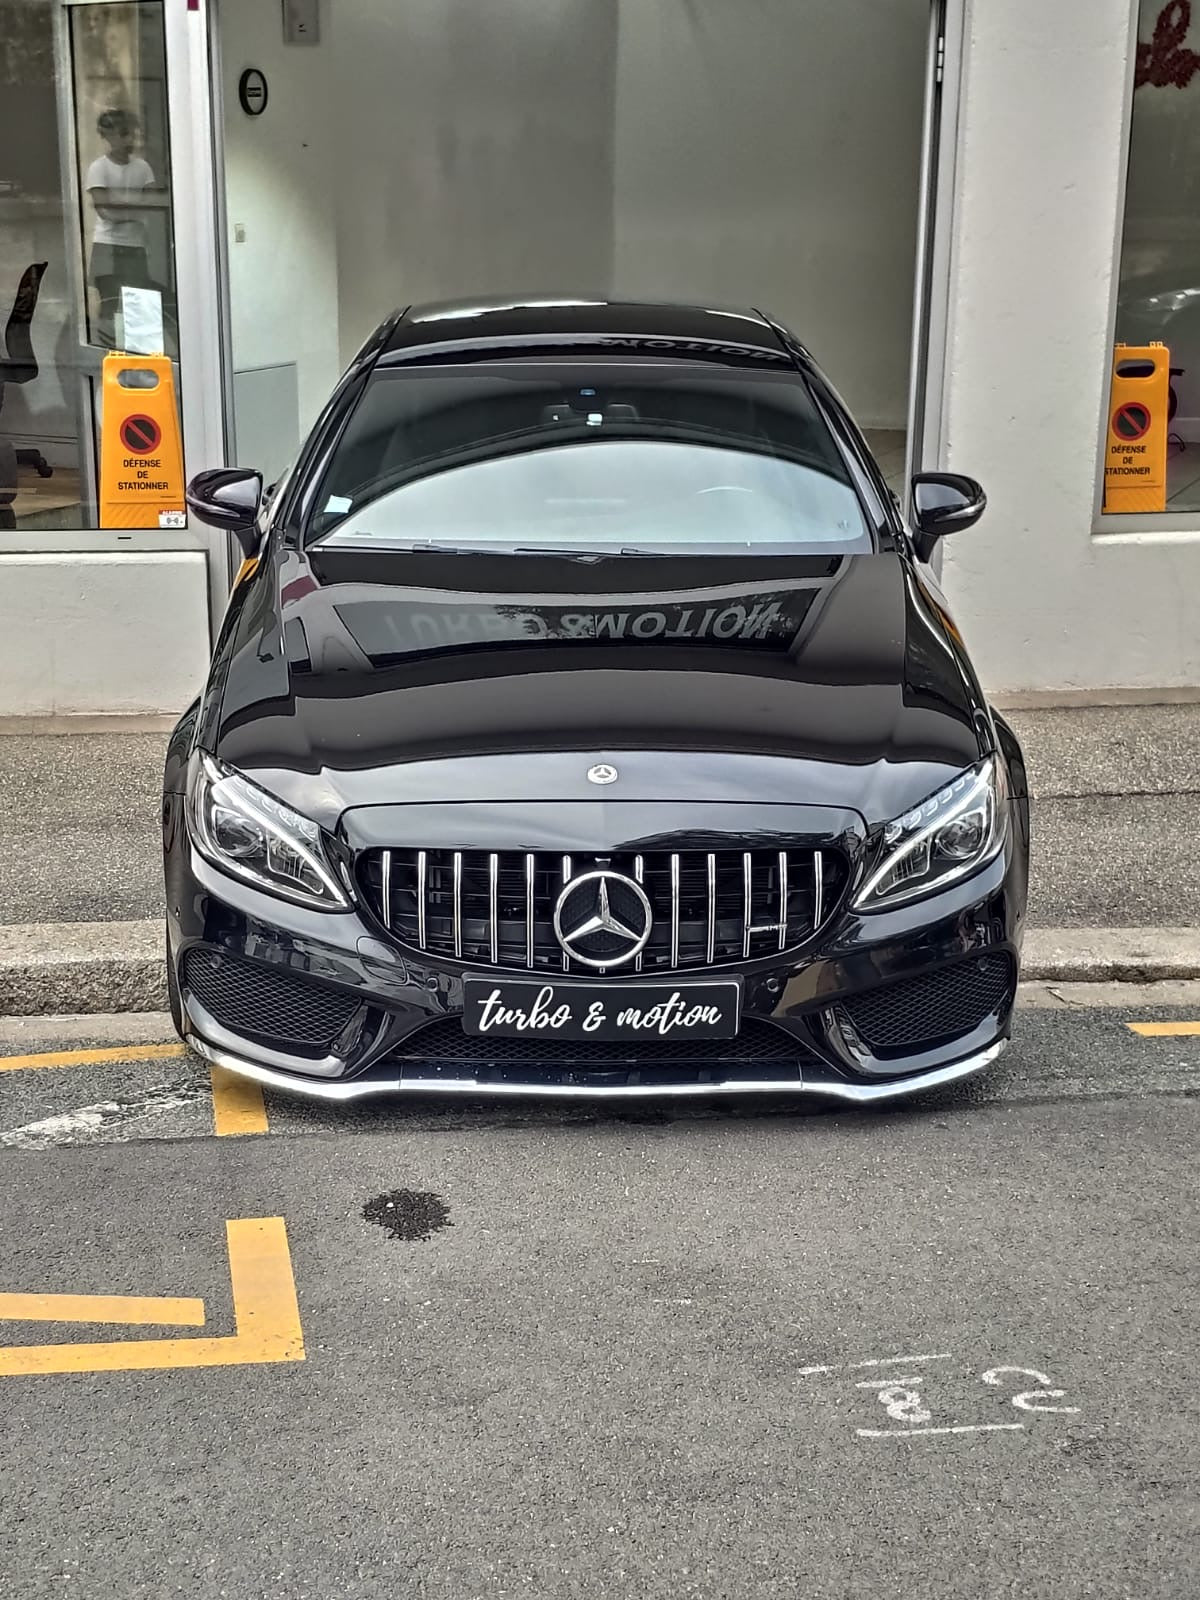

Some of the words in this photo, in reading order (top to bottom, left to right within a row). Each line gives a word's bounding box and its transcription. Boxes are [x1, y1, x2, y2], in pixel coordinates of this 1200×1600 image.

[1111, 444, 1146, 454] DÉFENSE
[123, 457, 161, 468] DÉFENSE
[1122, 456, 1133, 464] DE
[137, 470, 149, 479] DE
[118, 481, 168, 490] STATIONNER
[478, 986, 572, 1032] turbo
[582, 1001, 606, 1032] &
[616, 992, 722, 1035] motion
